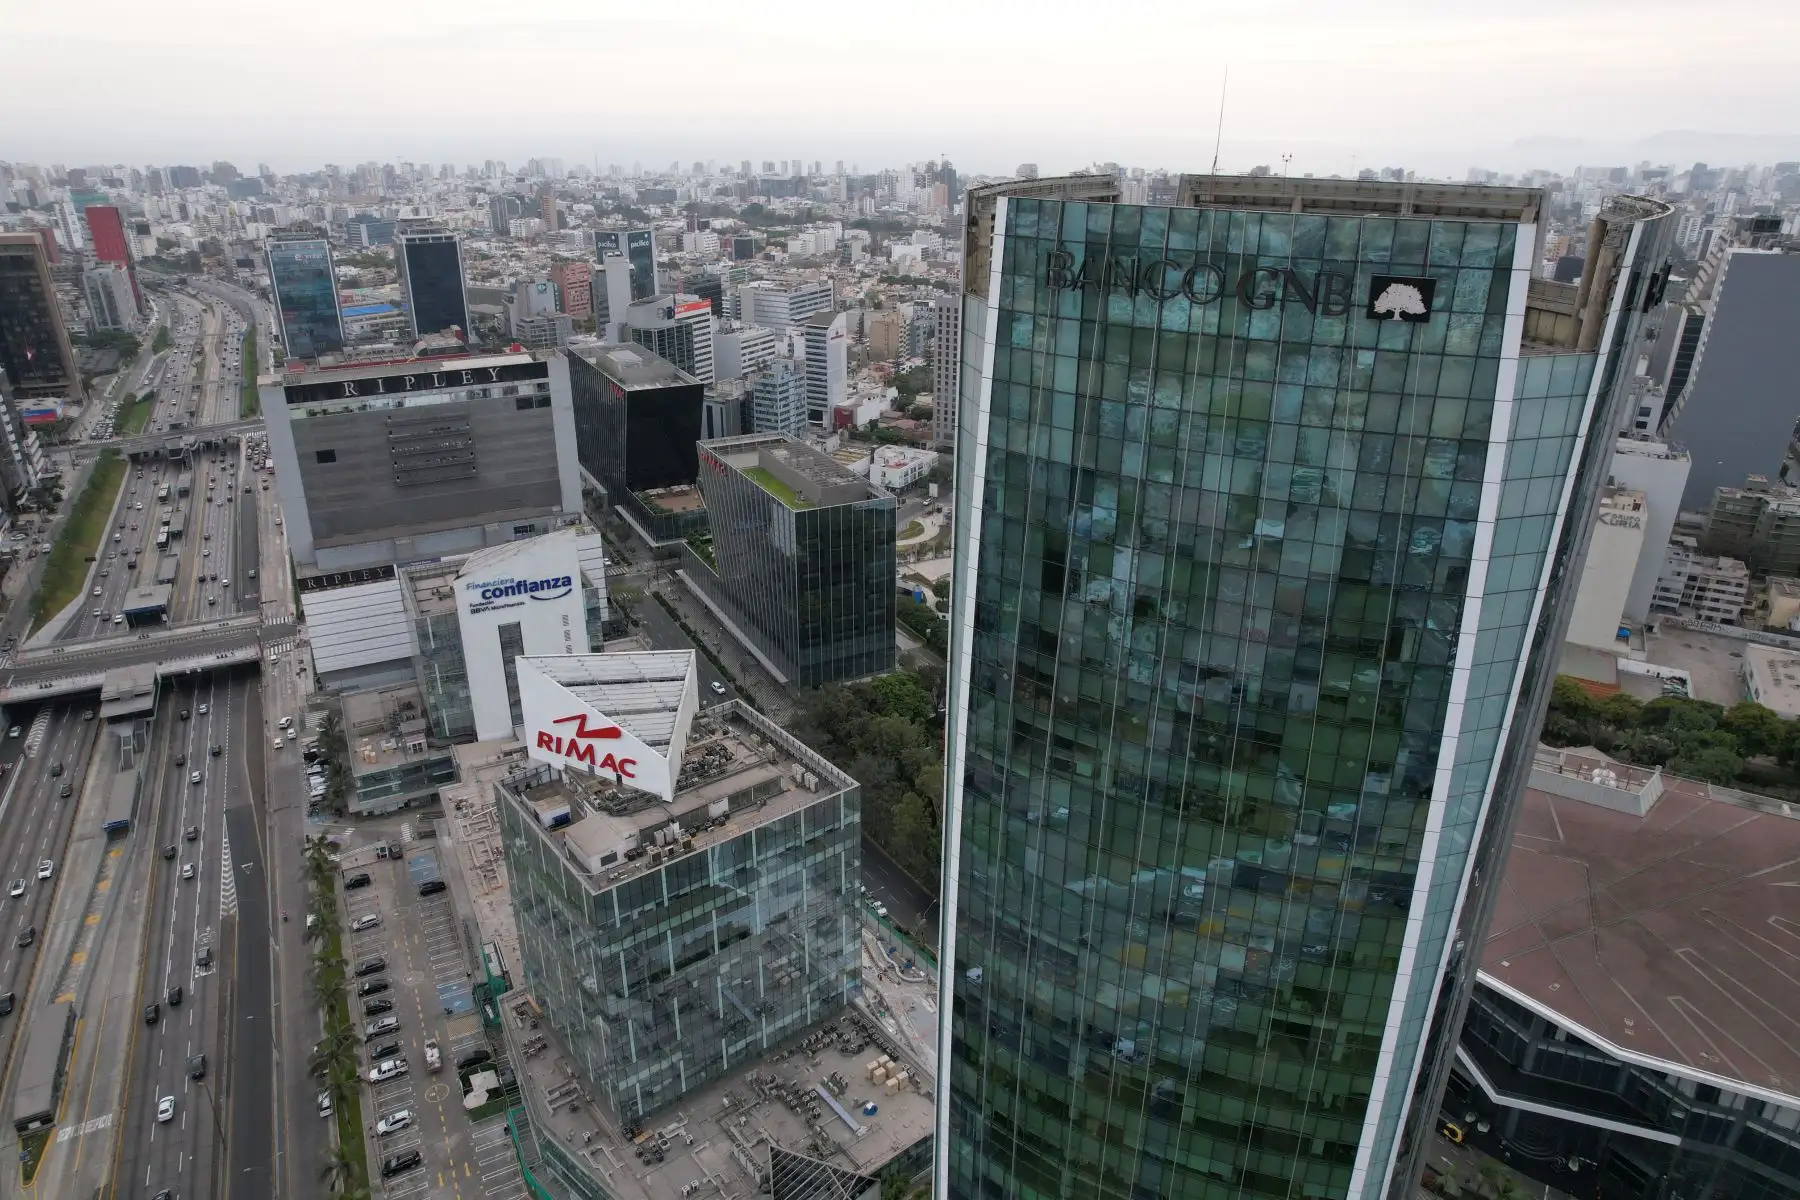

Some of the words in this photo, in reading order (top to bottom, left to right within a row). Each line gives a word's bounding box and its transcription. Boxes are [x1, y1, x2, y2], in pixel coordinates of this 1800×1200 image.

[1046, 250, 1226, 305] BANCO
[1236, 265, 1352, 317] GNB
[343, 367, 502, 397] RIPLEY
[307, 567, 387, 589] RIPLEY
[466, 577, 515, 591] Financiera
[481, 575, 573, 600] confianza
[536, 730, 637, 779] RIMAC
